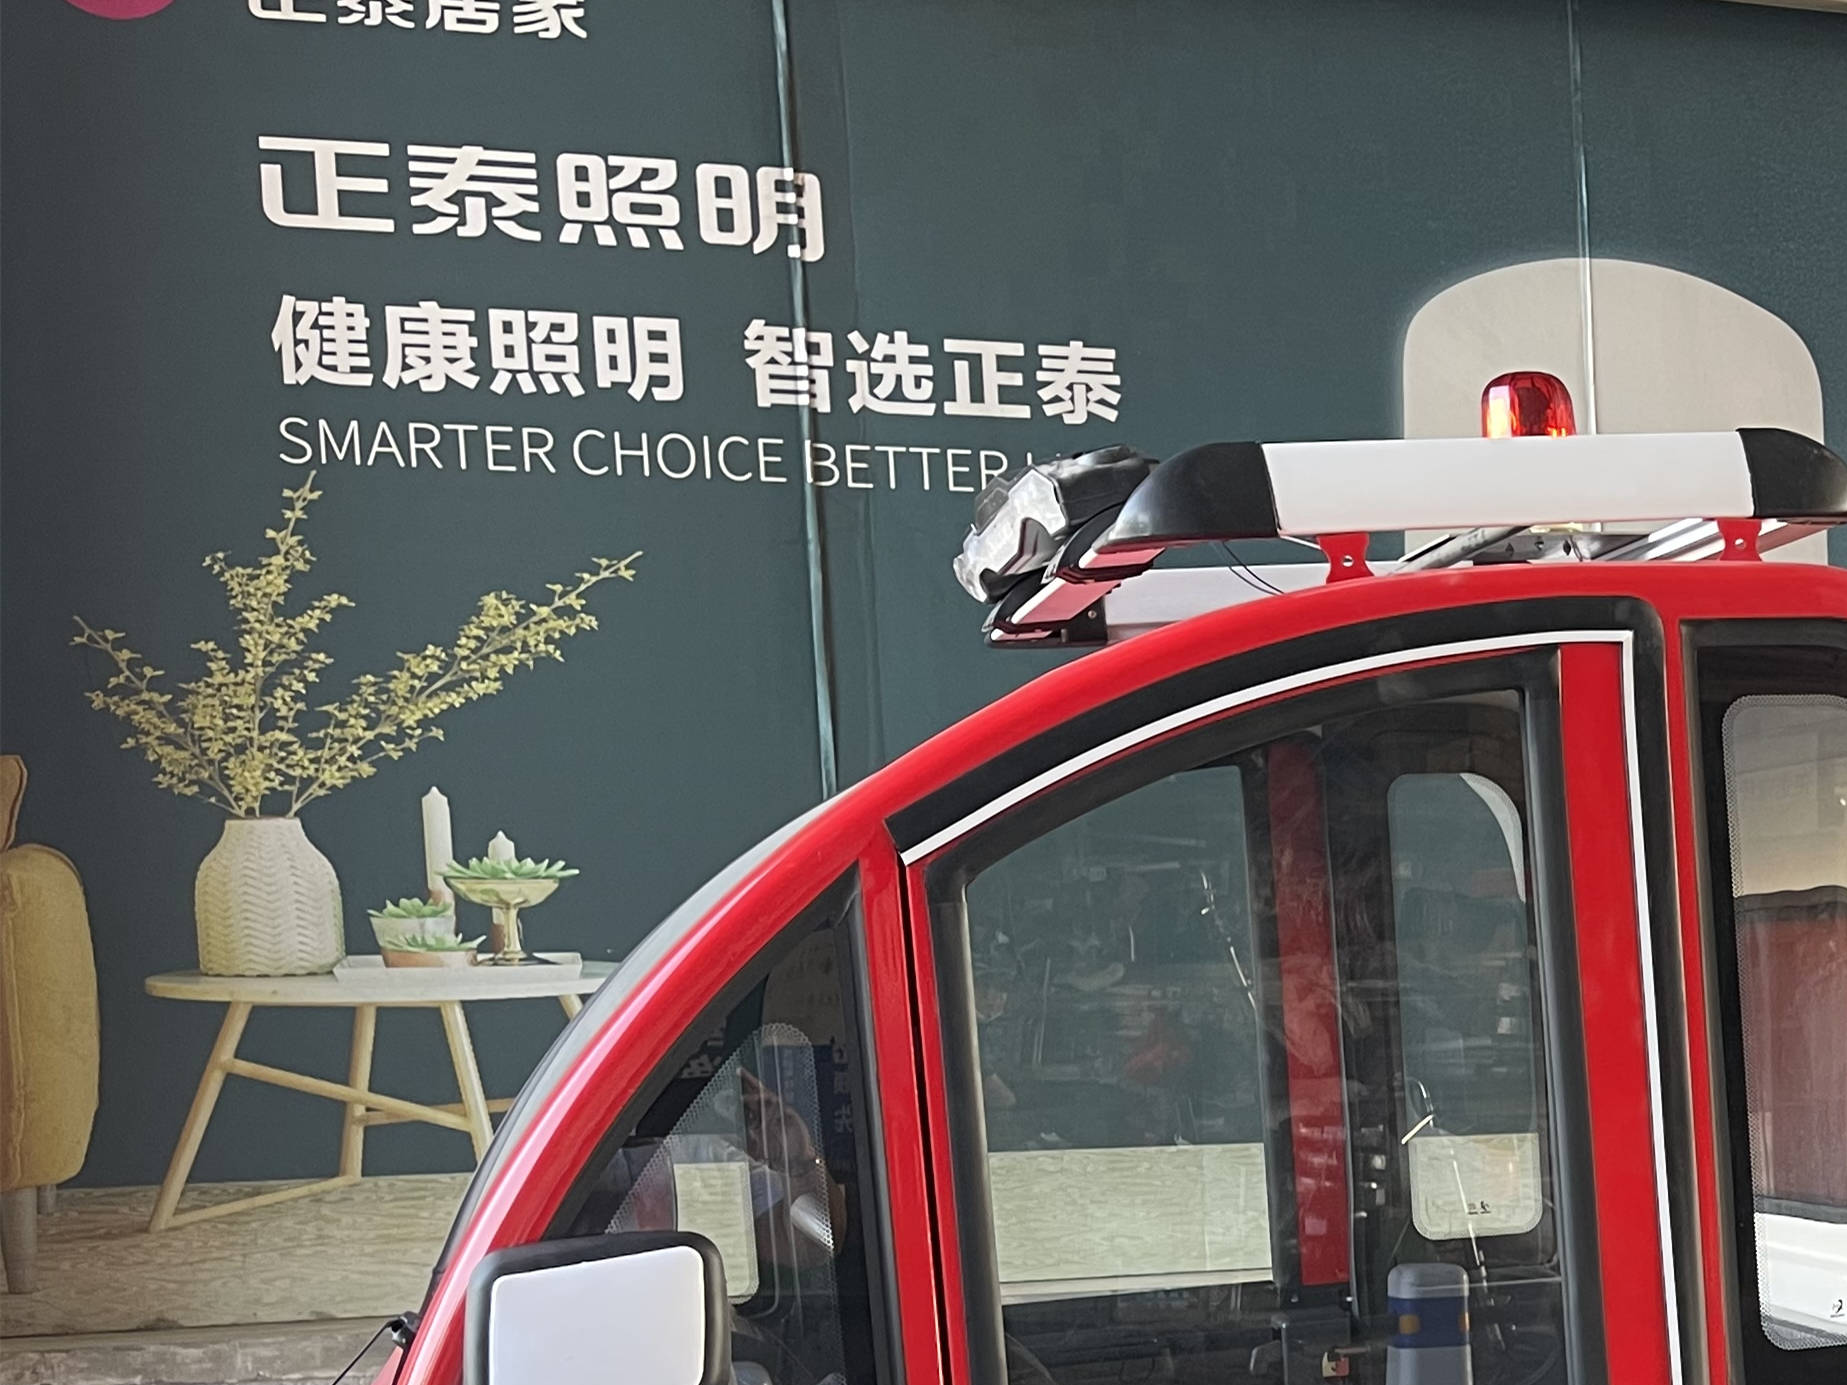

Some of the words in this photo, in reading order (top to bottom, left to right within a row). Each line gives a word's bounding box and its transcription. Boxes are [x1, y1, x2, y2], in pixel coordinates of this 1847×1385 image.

[257, 135, 825, 262] 正泰照明
[271, 294, 684, 402] 健康照明
[744, 319, 1121, 424] 智选正泰
[279, 416, 555, 474] SMARTER
[573, 429, 787, 483] CHOICE
[805, 440, 1008, 493] BETTER
